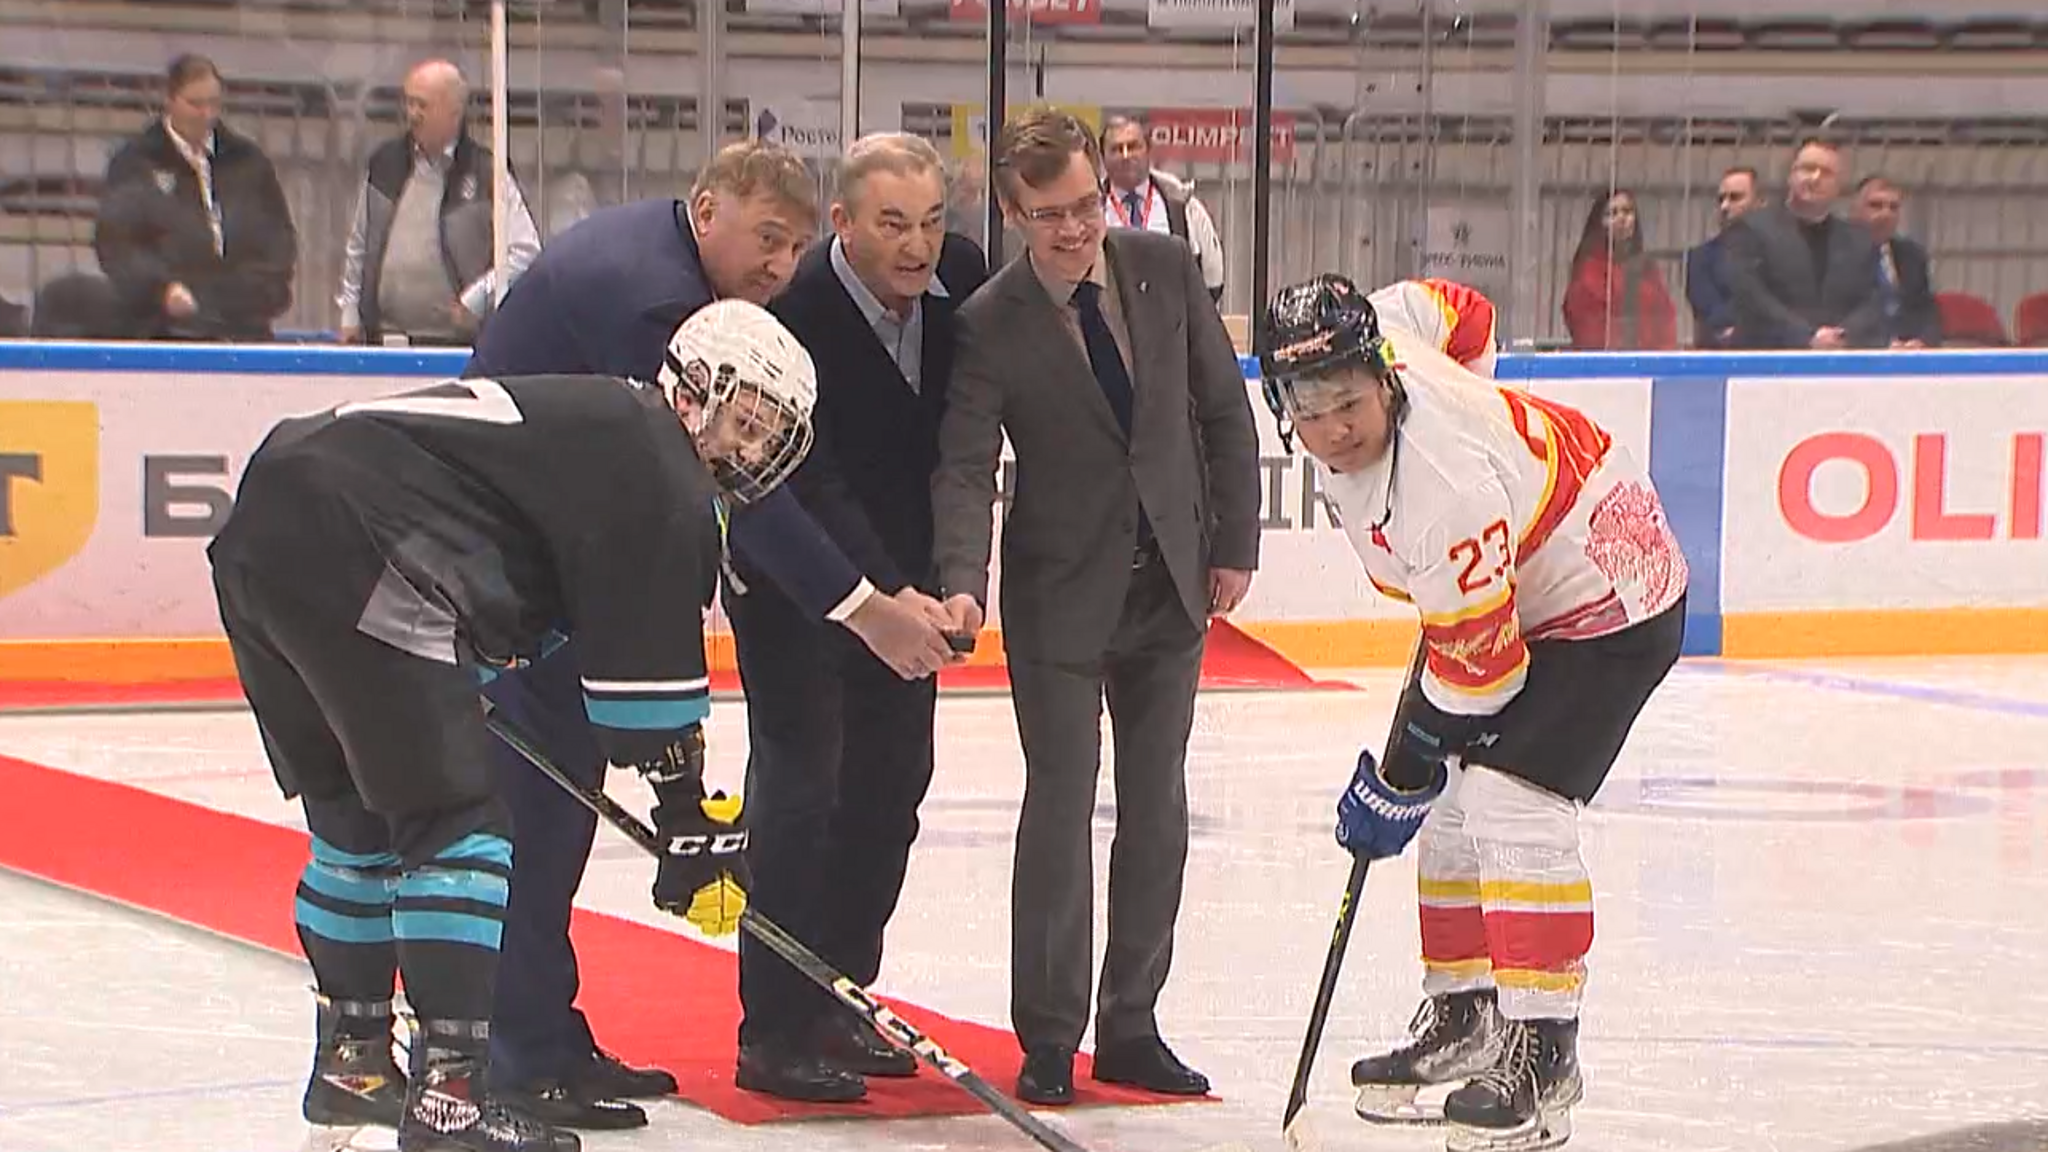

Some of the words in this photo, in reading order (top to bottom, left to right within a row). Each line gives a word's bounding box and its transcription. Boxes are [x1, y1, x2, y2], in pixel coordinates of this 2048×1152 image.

[1151, 125, 1293, 148] OLIMPT
[1779, 432, 2042, 542] OLI
[1449, 519, 1512, 595] 23
[668, 829, 750, 856] CC
